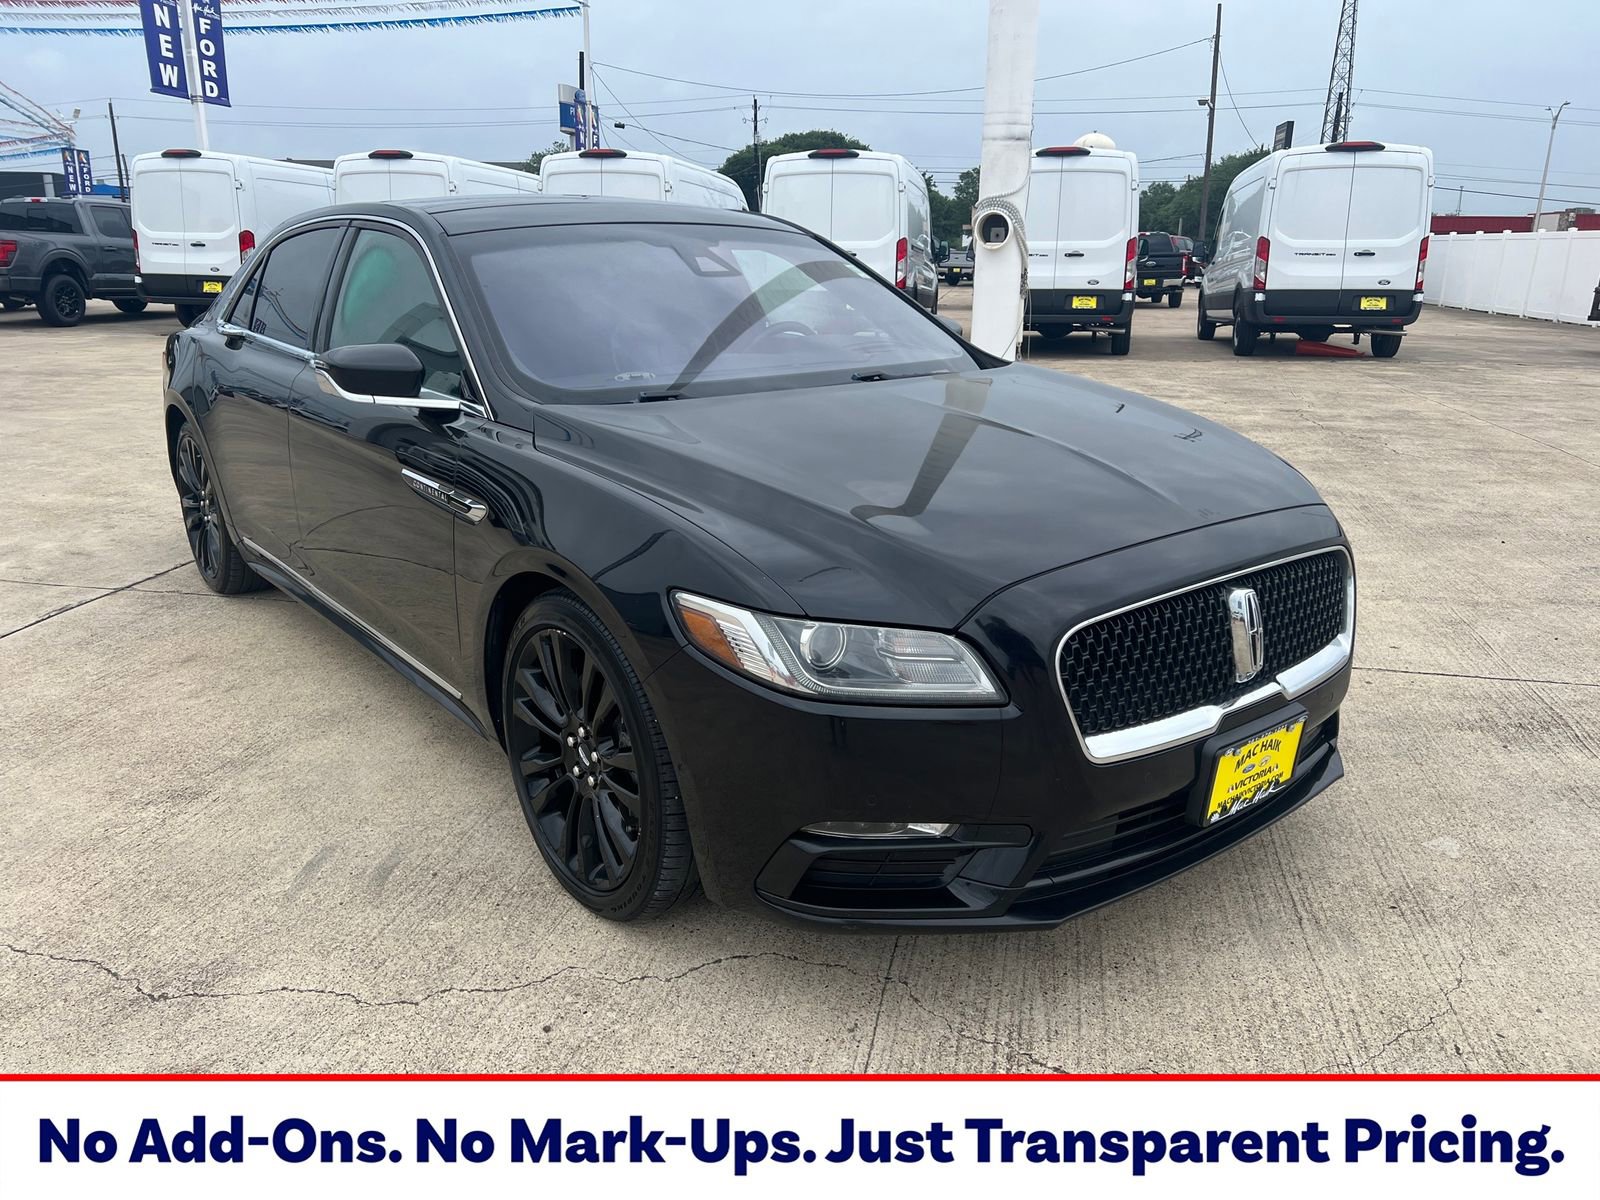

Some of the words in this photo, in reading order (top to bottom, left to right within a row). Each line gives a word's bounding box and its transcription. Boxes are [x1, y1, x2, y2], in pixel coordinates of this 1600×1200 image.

[153, 3, 178, 88] NEW
[199, 17, 219, 98] FORD
[412, 480, 448, 502] CONTINENTAL
[1234, 743, 1260, 773] MAC
[1260, 738, 1282, 753] HAIK
[1234, 765, 1275, 790] VICTORIA
